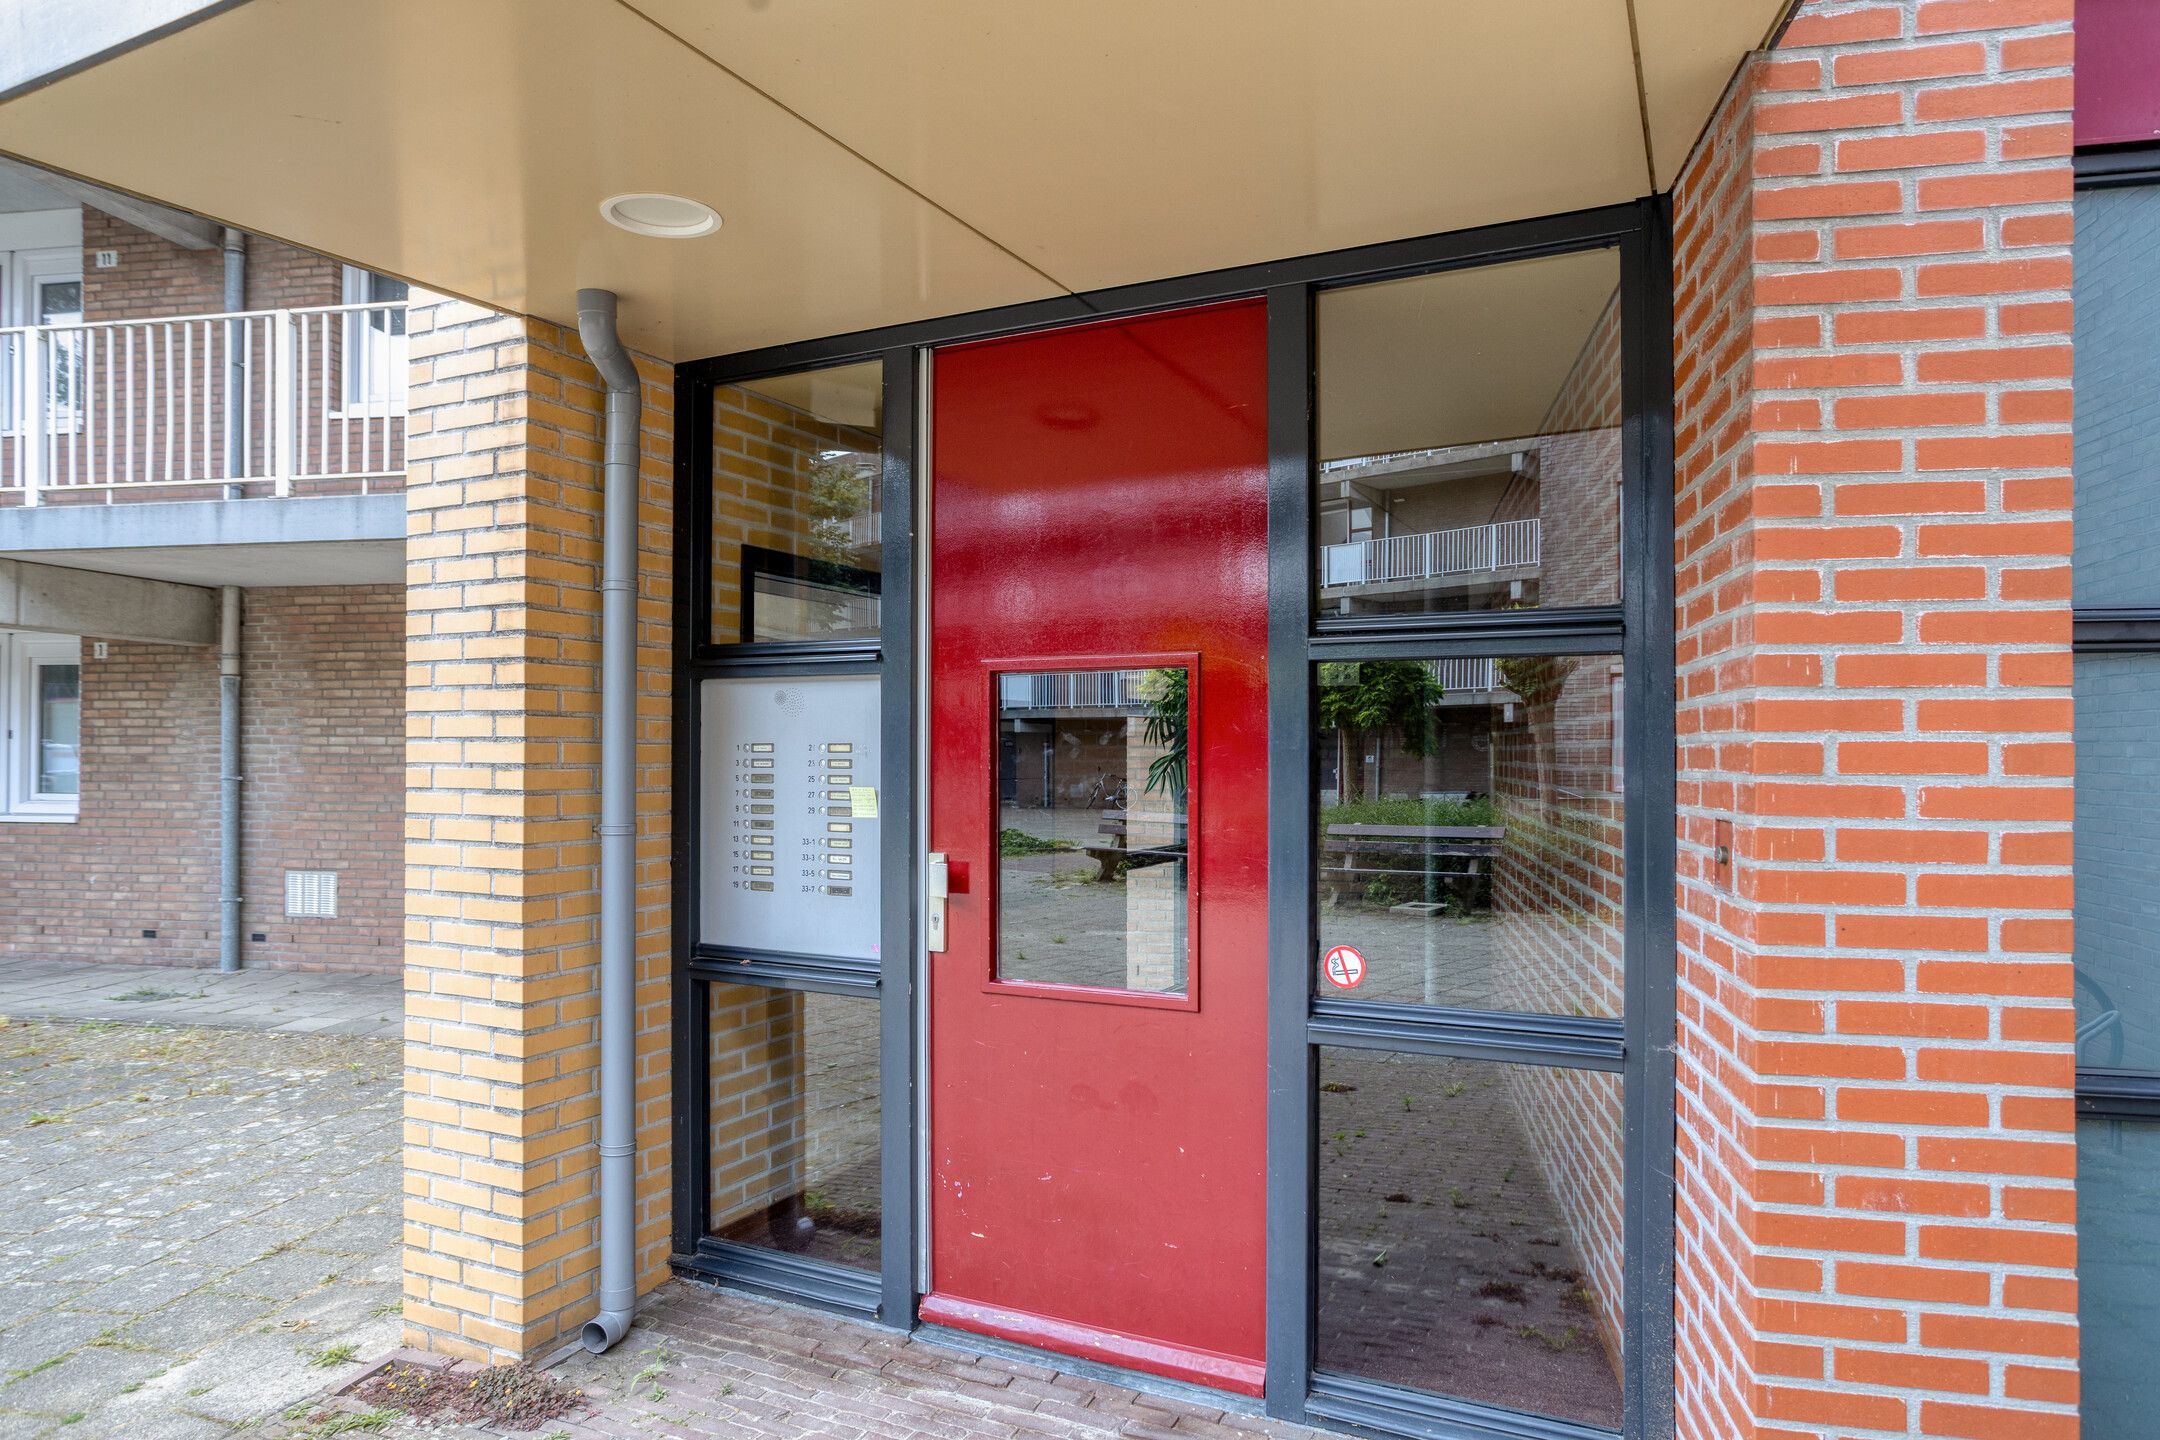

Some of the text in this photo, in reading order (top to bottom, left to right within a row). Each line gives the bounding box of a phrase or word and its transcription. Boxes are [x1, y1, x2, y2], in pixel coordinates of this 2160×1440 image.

[807, 775, 816, 783] 25
[807, 806, 816, 814] 29
[732, 835, 739, 843] 13
[802, 838, 816, 846] 33-1
[732, 850, 739, 858] 15
[802, 853, 815, 861] 33-3
[732, 865, 739, 873] 17
[802, 869, 815, 877] 33-5
[732, 880, 739, 888] 19
[802, 885, 815, 893] 33-7
